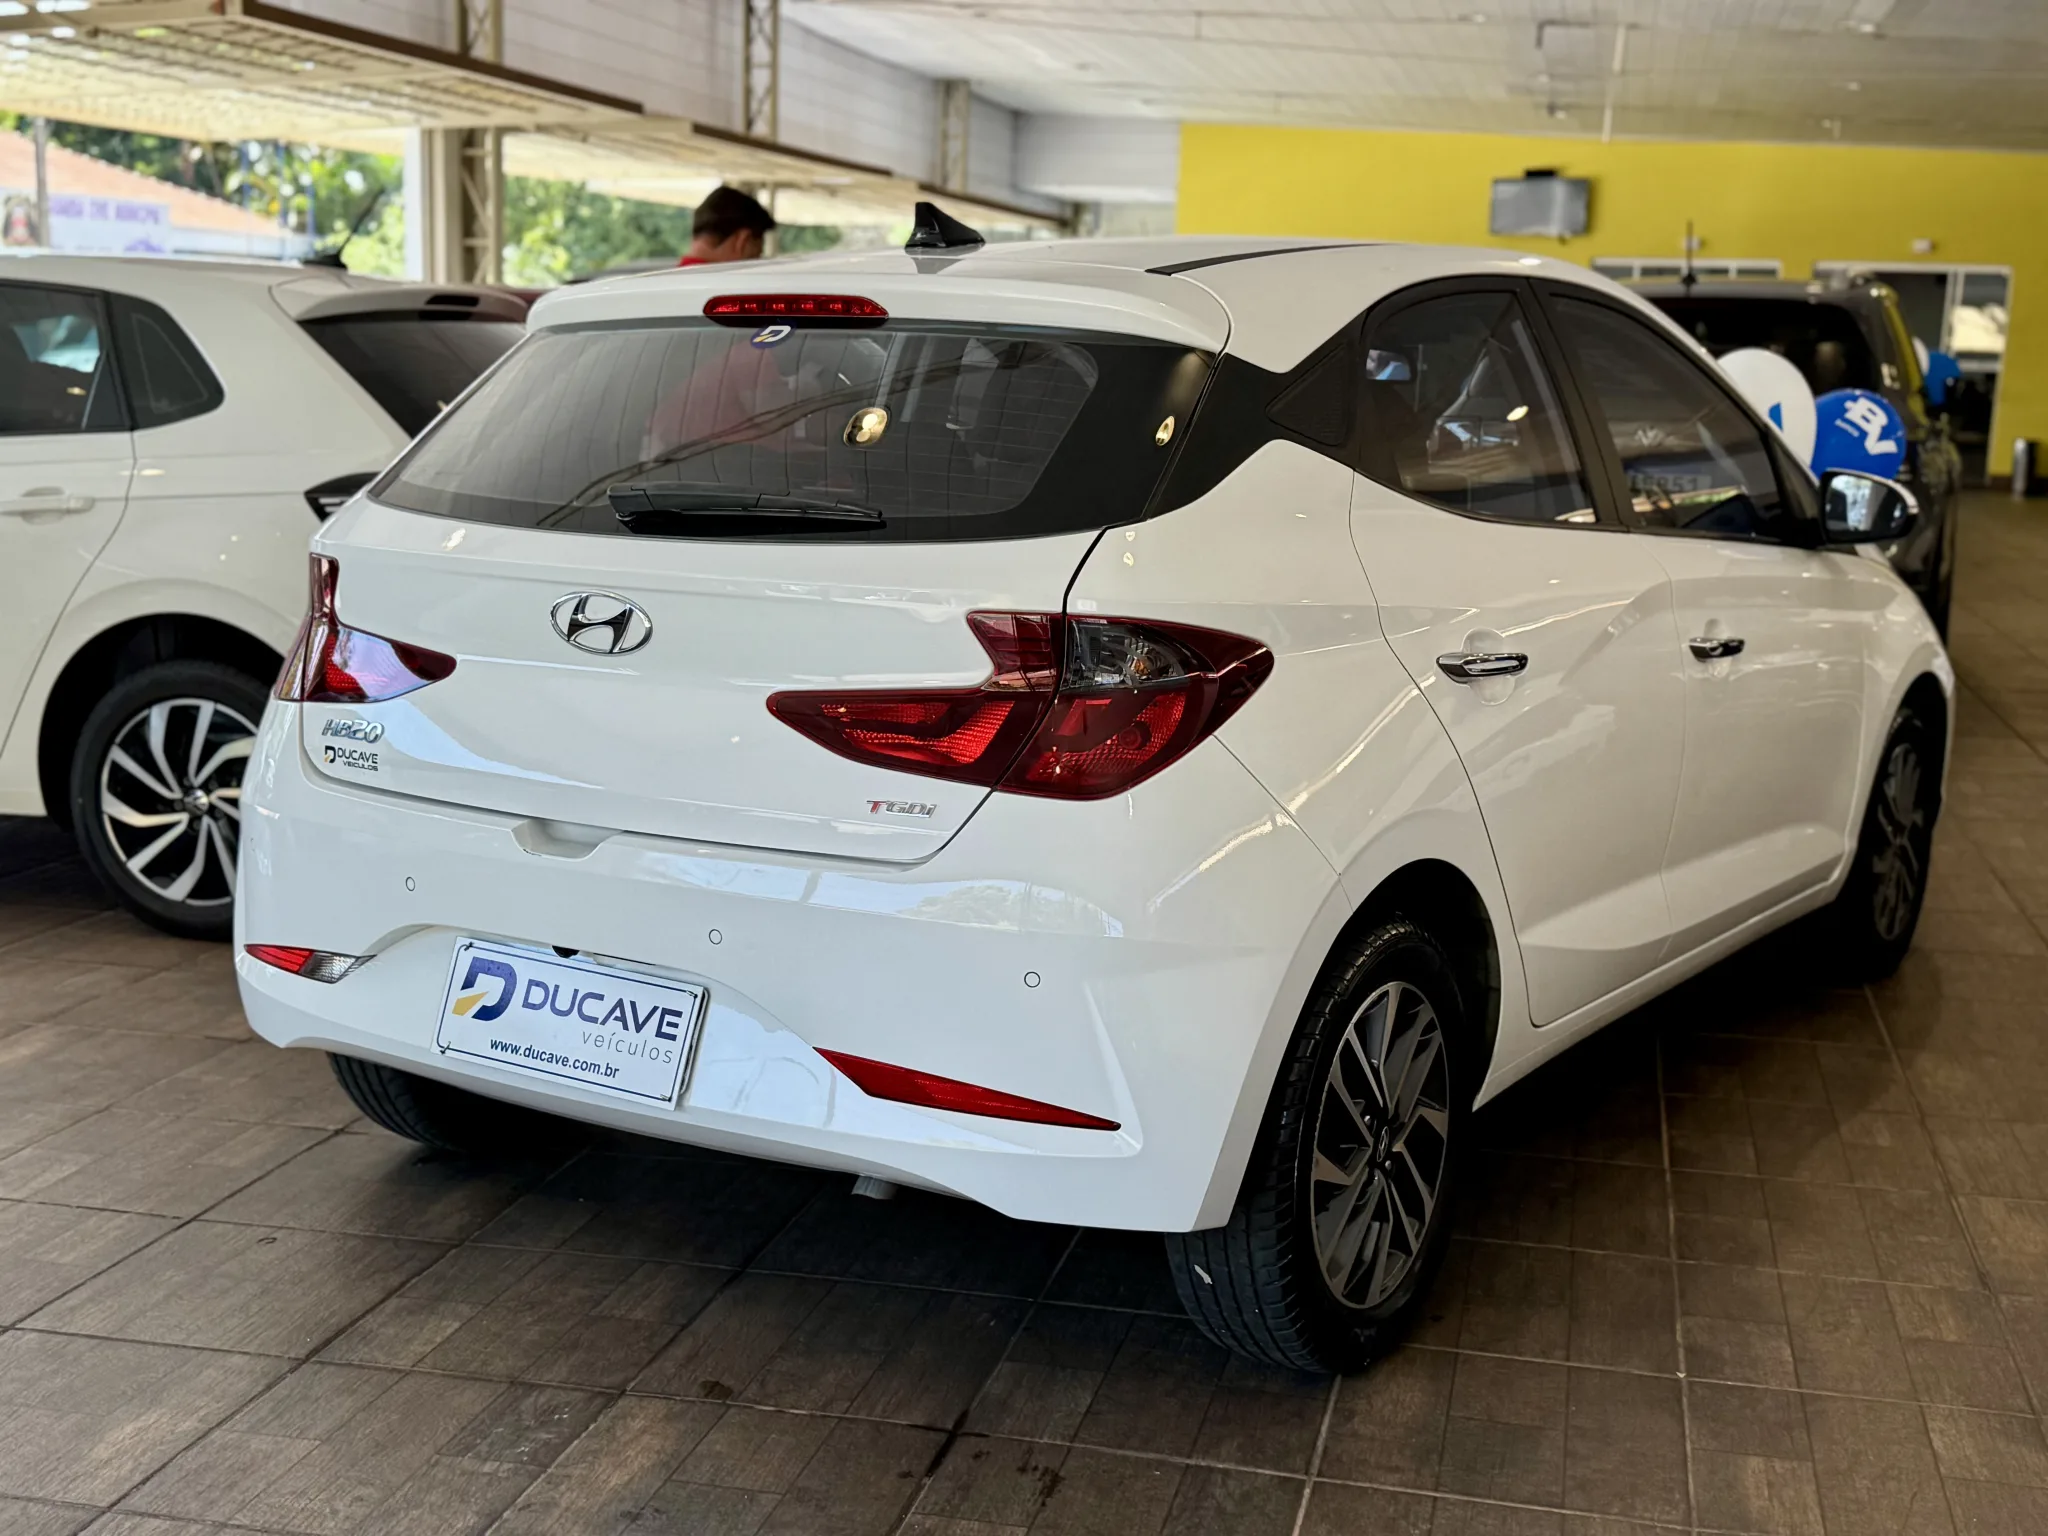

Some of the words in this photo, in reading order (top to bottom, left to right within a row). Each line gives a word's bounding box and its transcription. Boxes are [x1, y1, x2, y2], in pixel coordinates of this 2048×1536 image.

[321, 719, 385, 744] HB20
[337, 747, 379, 765] DUCAVE
[342, 760, 379, 772] VEICULOS
[521, 978, 684, 1042] DUCAVE
[489, 1037, 620, 1079] www.ducave.com.br
[581, 1029, 674, 1065] veículos
